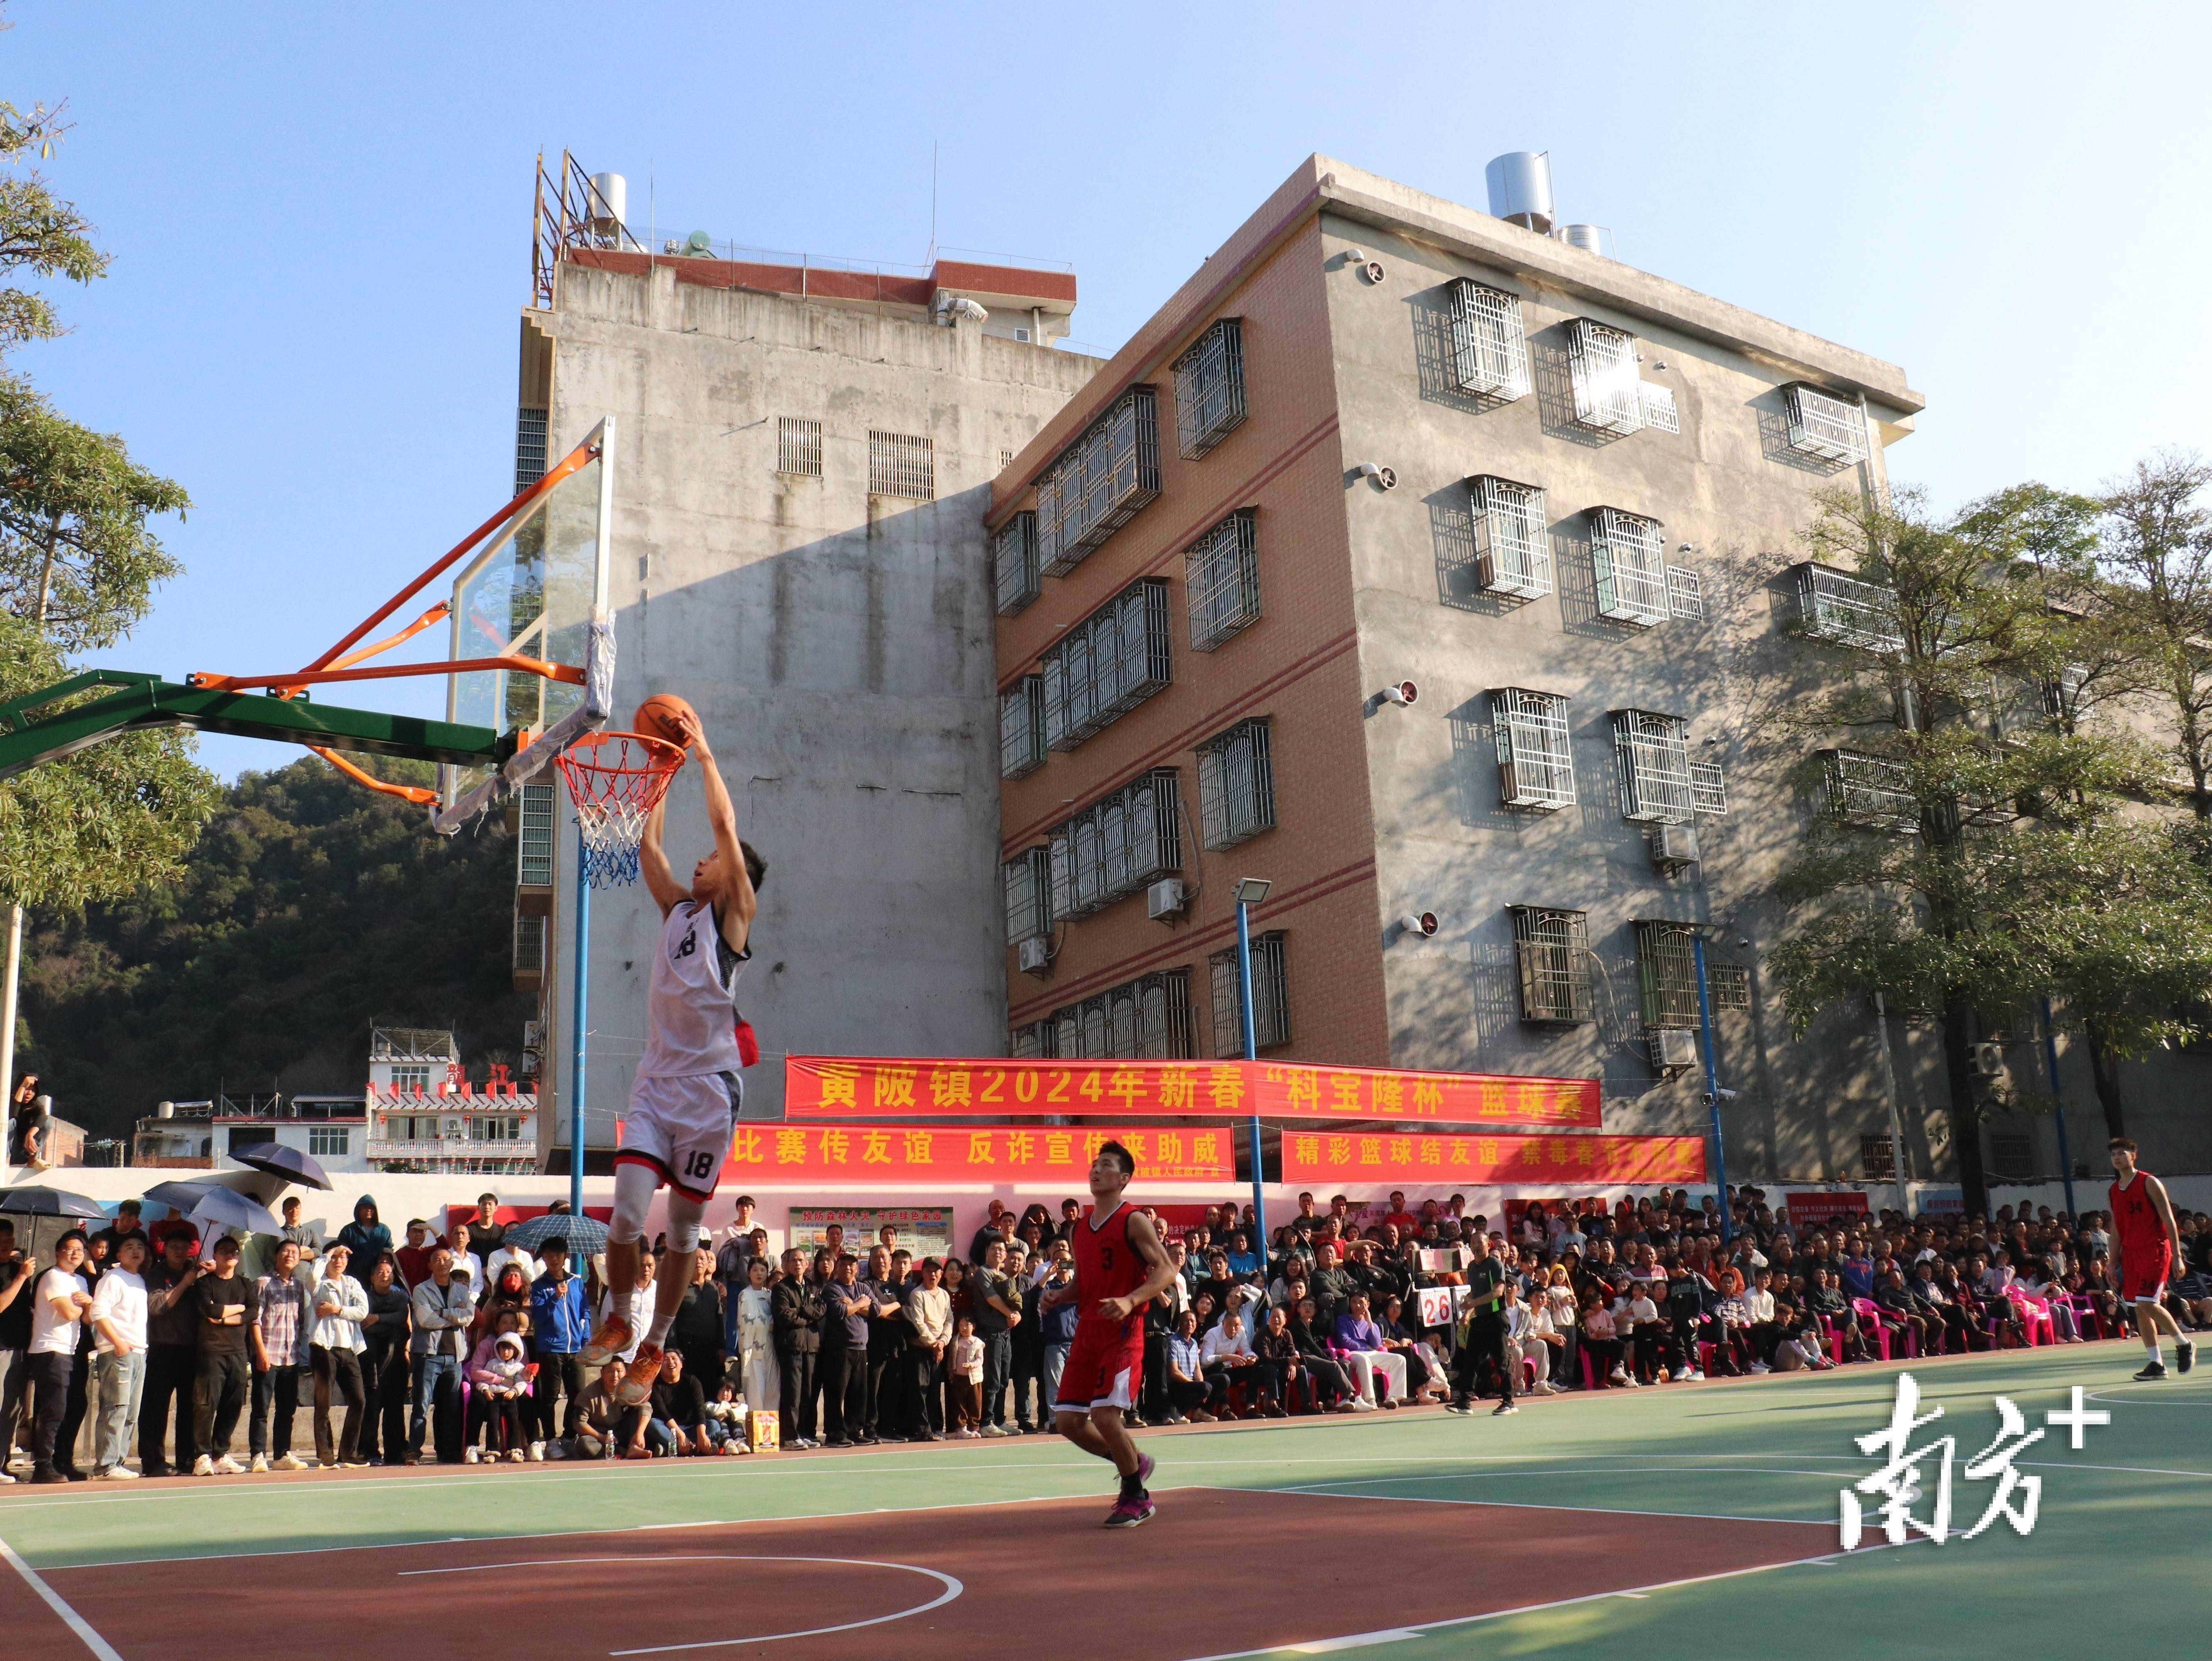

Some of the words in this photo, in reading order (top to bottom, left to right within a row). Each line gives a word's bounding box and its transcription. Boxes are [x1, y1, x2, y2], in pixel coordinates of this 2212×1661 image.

[1296, 1136, 1499, 1165] 精彩篮球结友谊
[685, 1150, 714, 1179] 18
[803, 1210, 870, 1221] 预防森林火灾
[877, 1210, 942, 1221] 守护绿色家园
[2129, 1200, 2142, 1214] 34
[1101, 1247, 1113, 1270] 3
[1424, 1295, 1450, 1324] 26
